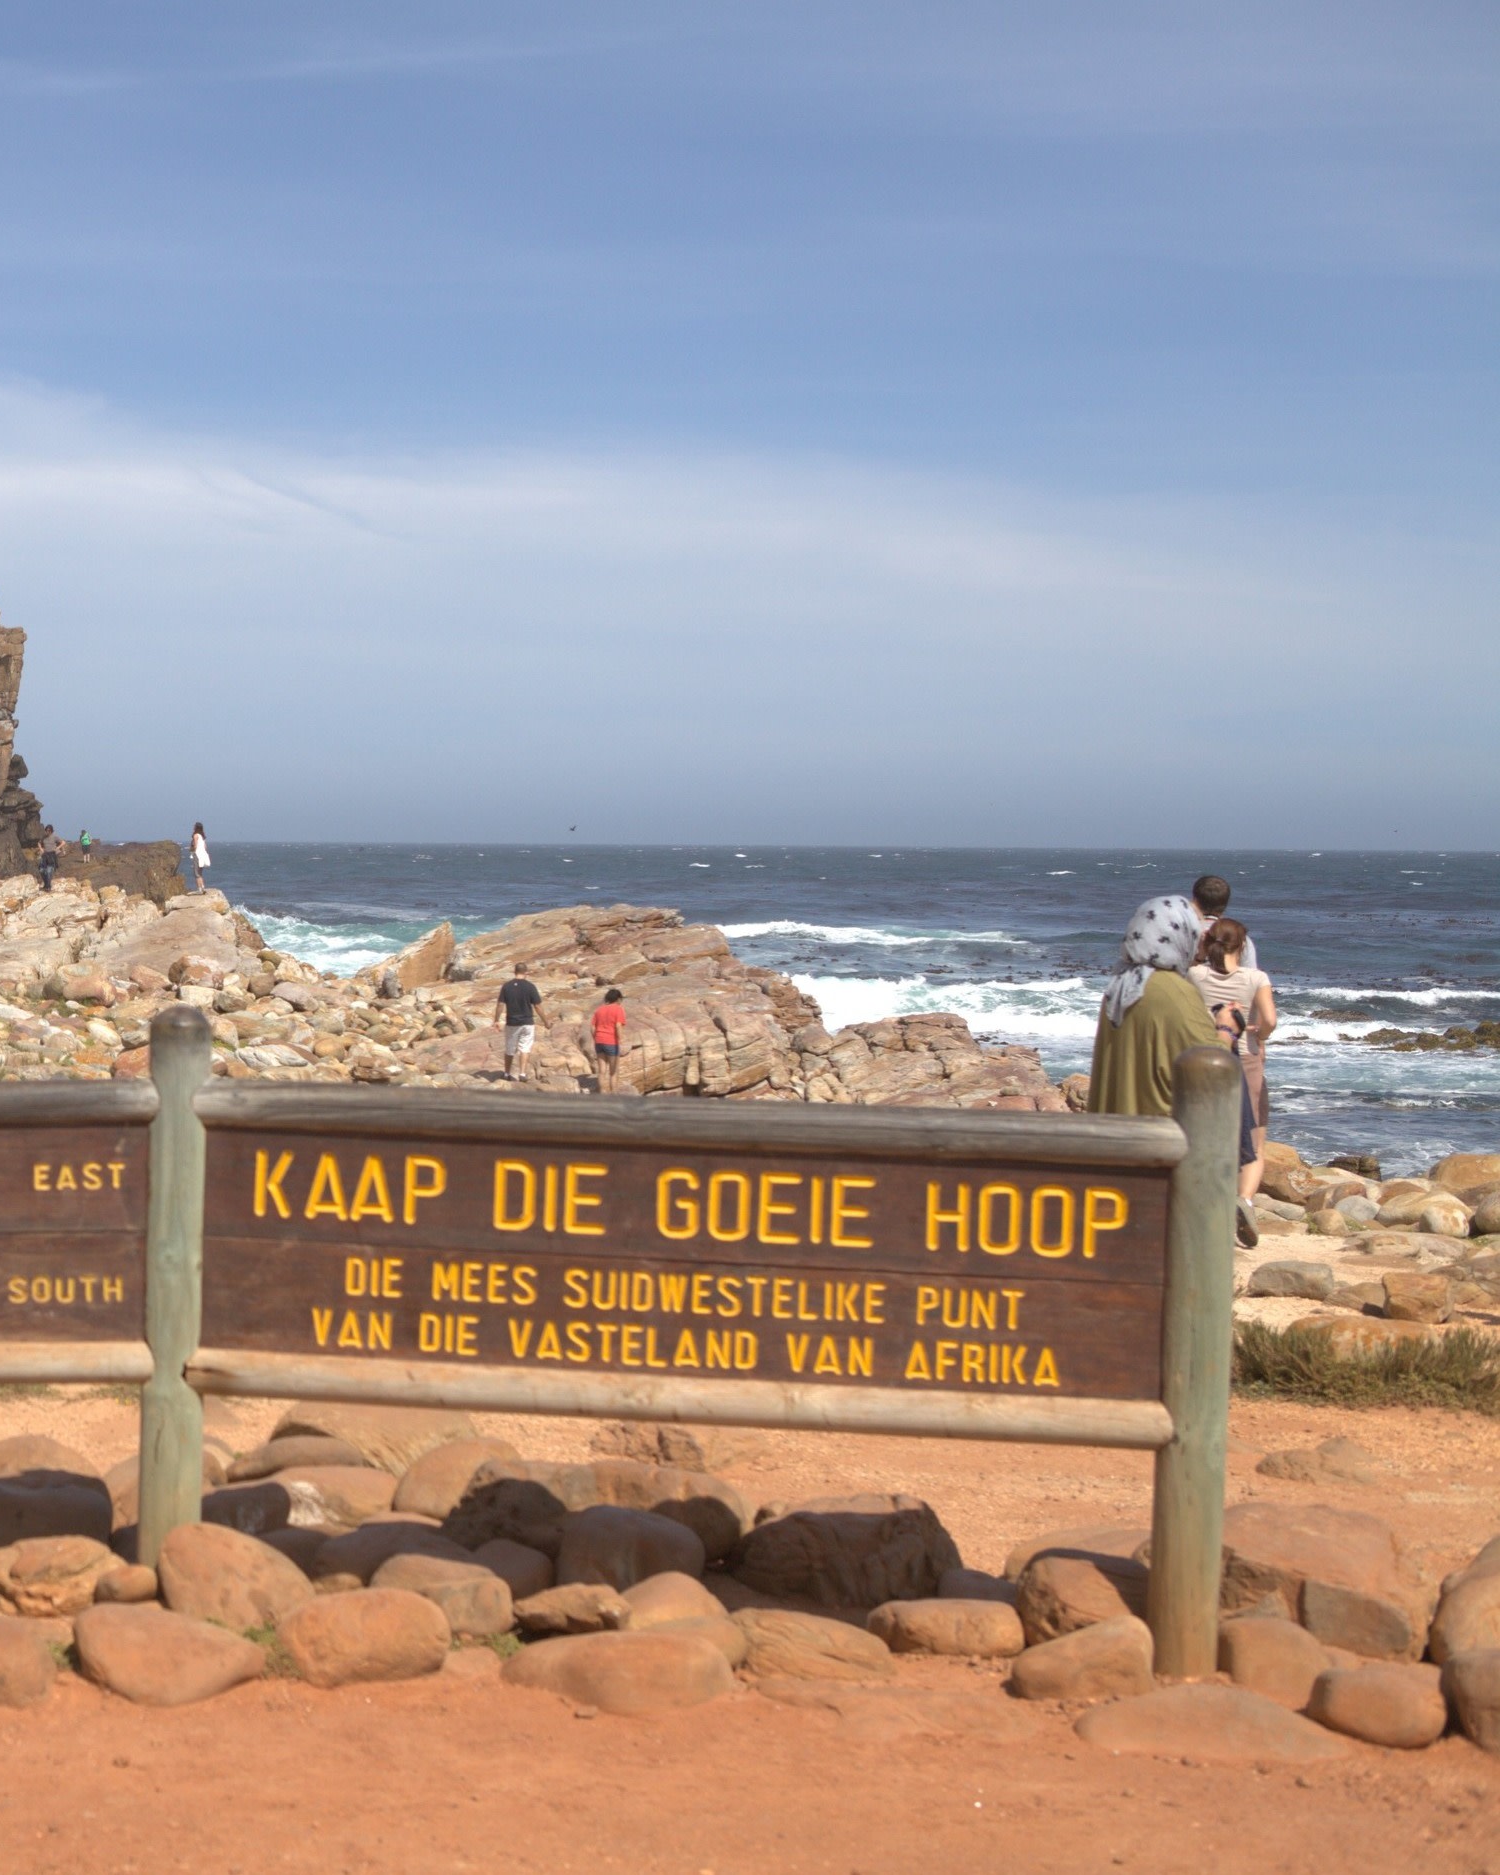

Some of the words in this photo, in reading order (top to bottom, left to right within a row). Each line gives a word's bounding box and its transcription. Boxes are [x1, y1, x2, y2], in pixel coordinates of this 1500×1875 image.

[33, 1161, 125, 1191] EAST
[254, 1150, 447, 1225] KAAP
[493, 1159, 608, 1236] DIE
[656, 1168, 876, 1248] GOEIE
[926, 1182, 1128, 1258] HOOP
[8, 1274, 123, 1304] SOUTH
[345, 1256, 403, 1298] DIE
[432, 1261, 537, 1306] MEES
[563, 1269, 887, 1324] SUIDWESTELIKE
[916, 1285, 1025, 1331] PUNT
[312, 1308, 392, 1350] VAN
[419, 1312, 479, 1357] DIE
[508, 1318, 759, 1370] VASTELAND
[786, 1333, 874, 1377] VAN
[904, 1340, 1060, 1387] AFRIKA
